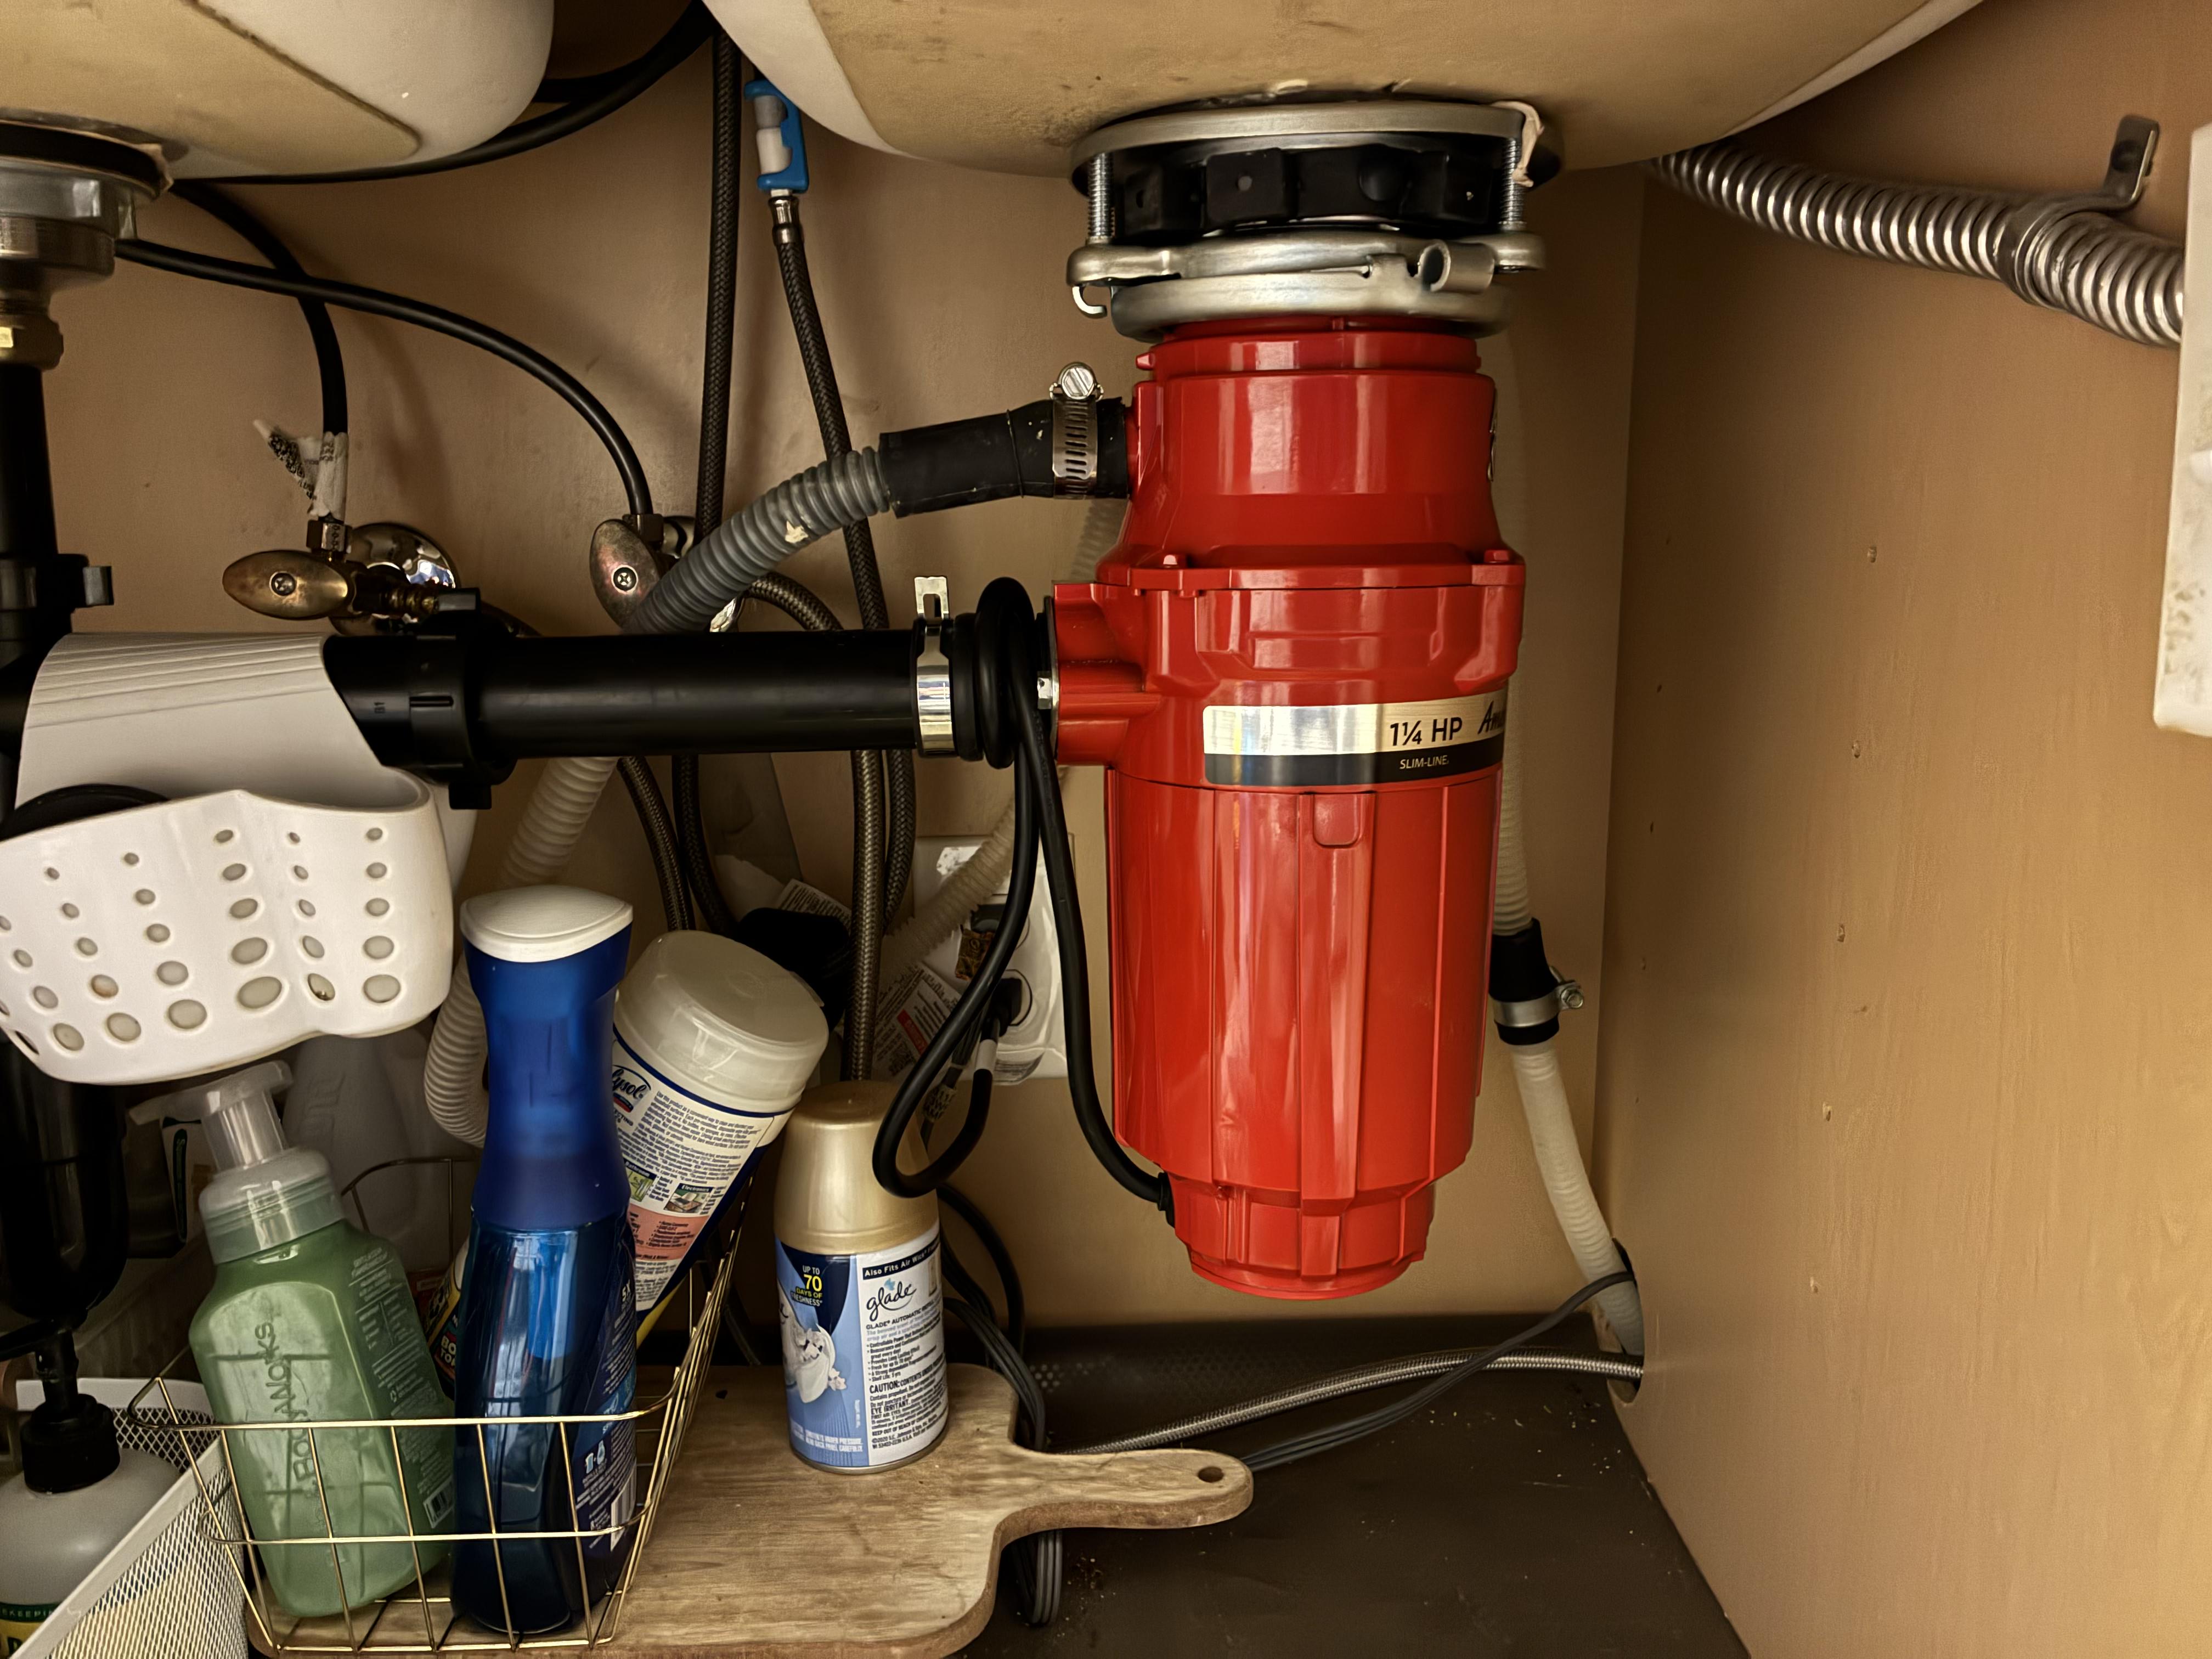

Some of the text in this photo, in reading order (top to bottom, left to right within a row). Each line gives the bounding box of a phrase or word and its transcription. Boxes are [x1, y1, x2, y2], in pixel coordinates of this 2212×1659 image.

[1431, 716, 1463, 742] HP
[1400, 755, 1449, 769] SLIM-LINE
[802, 1265, 820, 1275] UP TO
[884, 1263, 899, 1273] Fits
[901, 1259, 911, 1268] Air
[803, 1273, 822, 1292] 70
[796, 1287, 812, 1297] DAYS
[866, 1280, 917, 1322] glade
[892, 1308, 921, 1324] AUTOMATIC
[870, 1380, 900, 1394] CAUTION:
[871, 1406, 882, 1415] EYE
